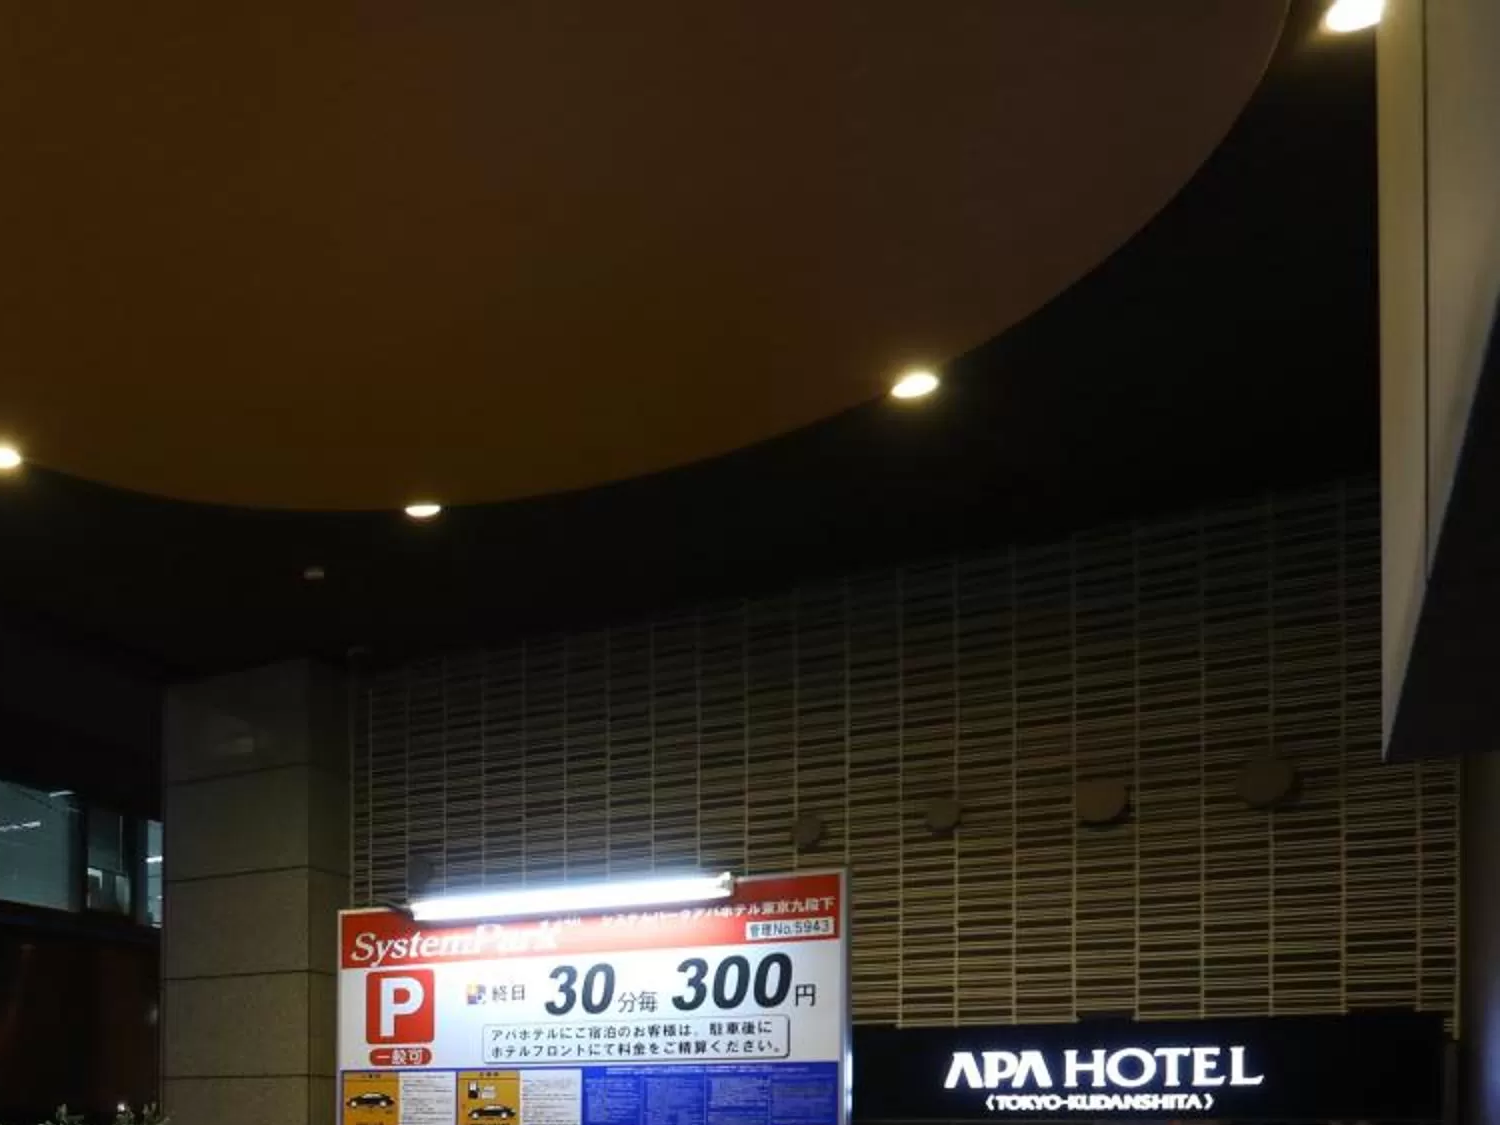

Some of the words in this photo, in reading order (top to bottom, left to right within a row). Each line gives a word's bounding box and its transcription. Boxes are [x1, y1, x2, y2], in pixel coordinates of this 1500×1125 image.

[351, 917, 564, 968] SystemPark
[380, 977, 425, 1038] P
[491, 984, 526, 1002] 終日
[376, 1049, 423, 1066] 一般可
[943, 1050, 1053, 1089] APA
[1063, 1046, 1265, 1088] HOTEL
